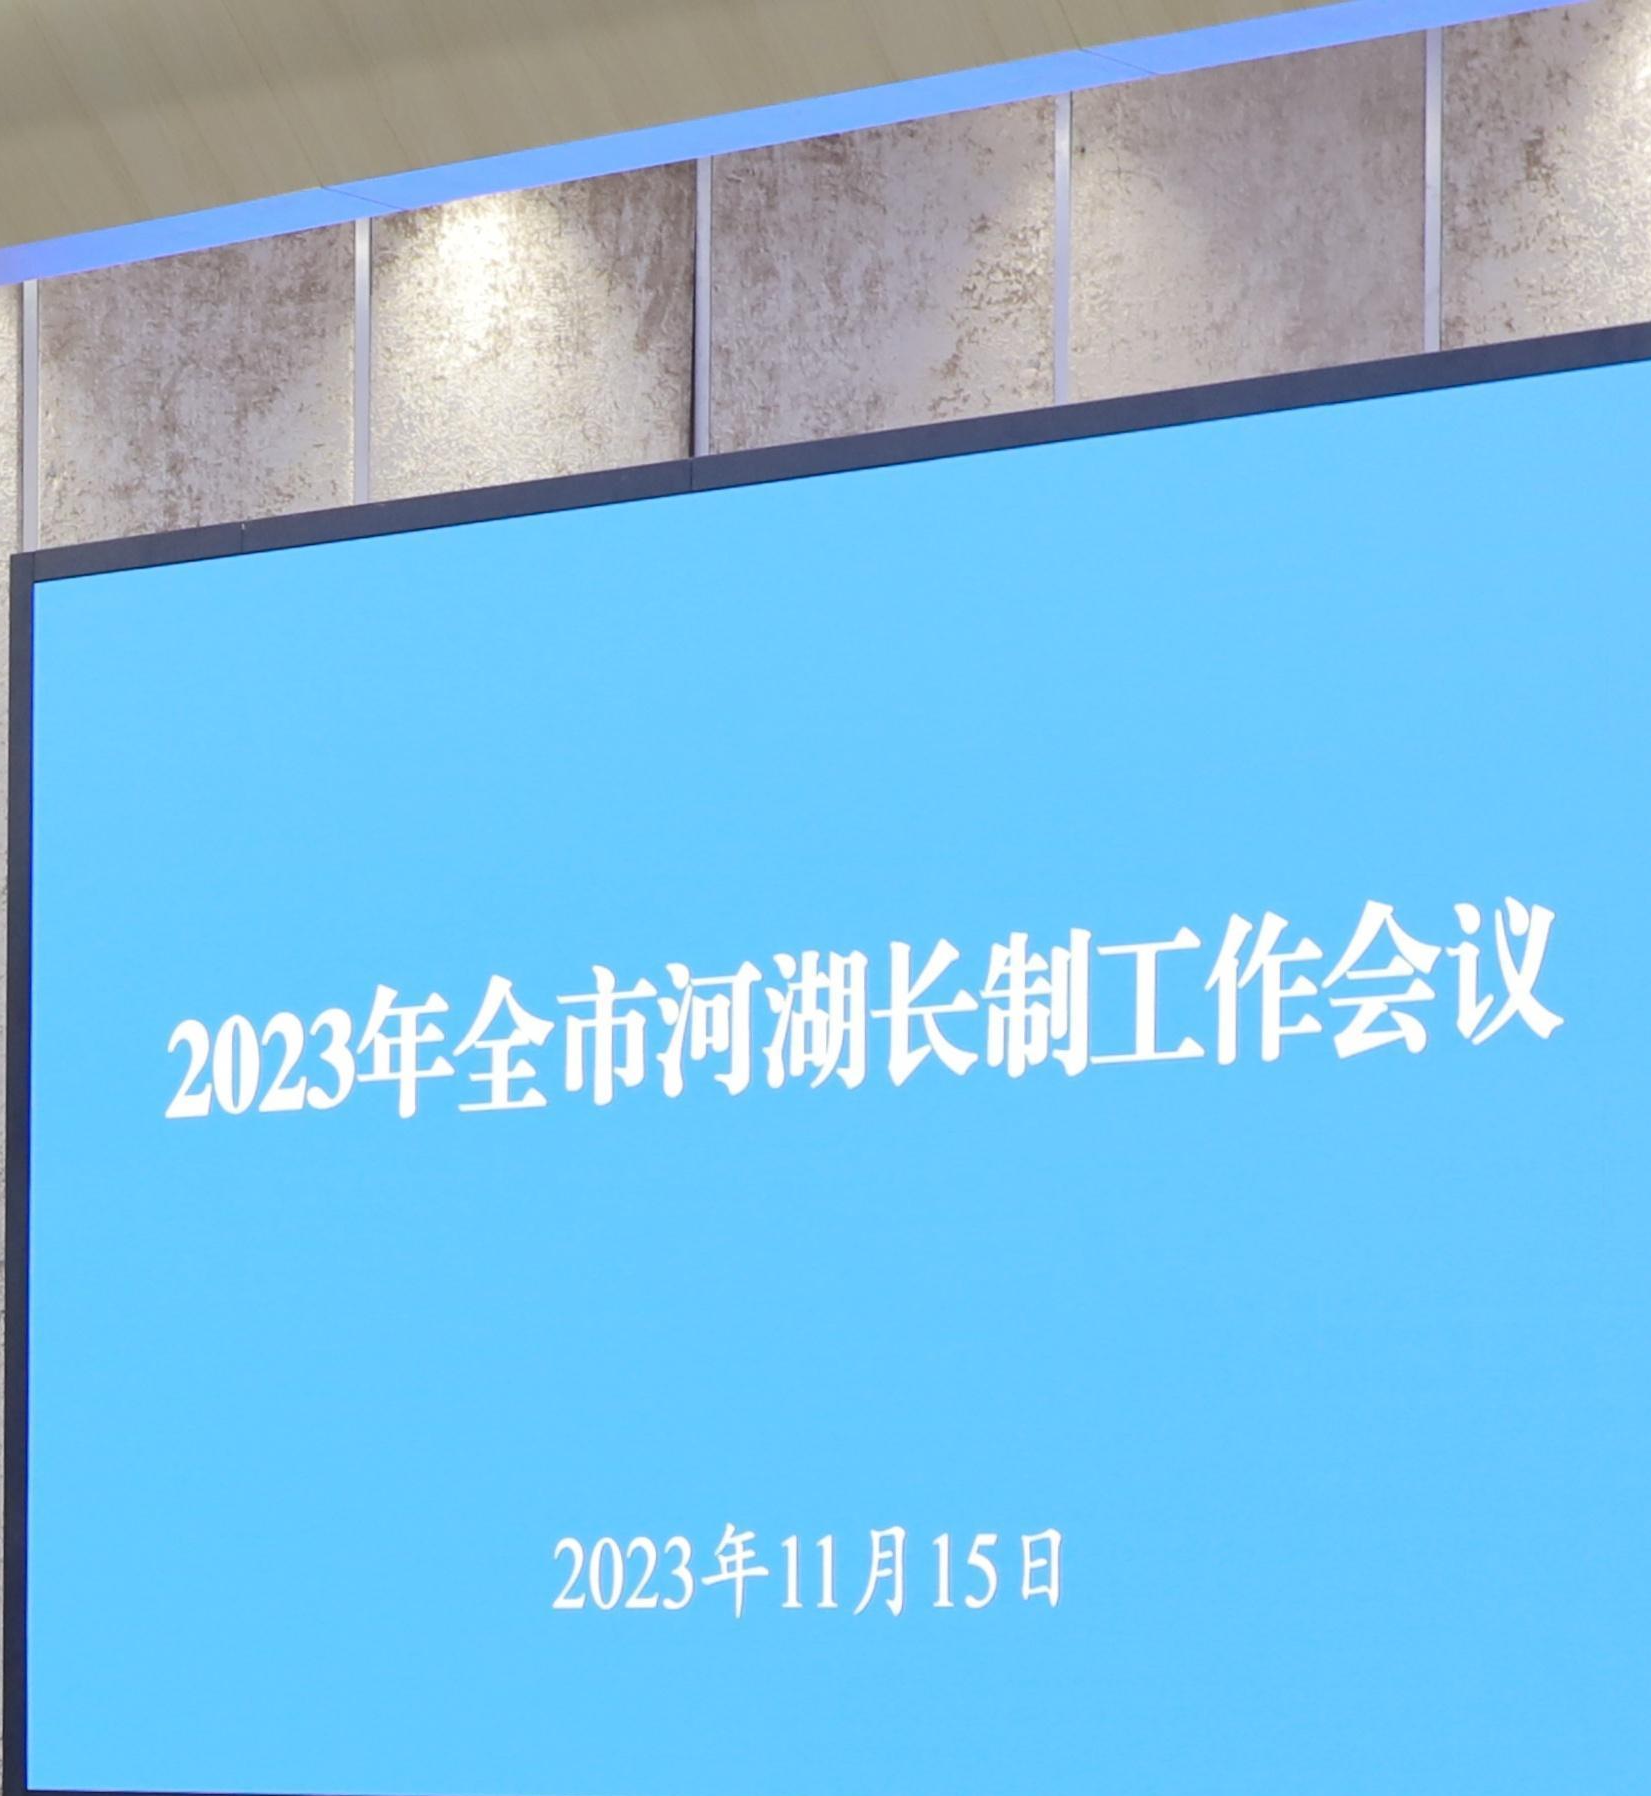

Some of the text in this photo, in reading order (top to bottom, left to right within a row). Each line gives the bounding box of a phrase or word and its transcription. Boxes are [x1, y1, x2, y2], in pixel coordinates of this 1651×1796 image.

[166, 896, 1565, 1119] 2023年全市河湖长制工作会议
[553, 1524, 1064, 1618] 2023年11月15日
